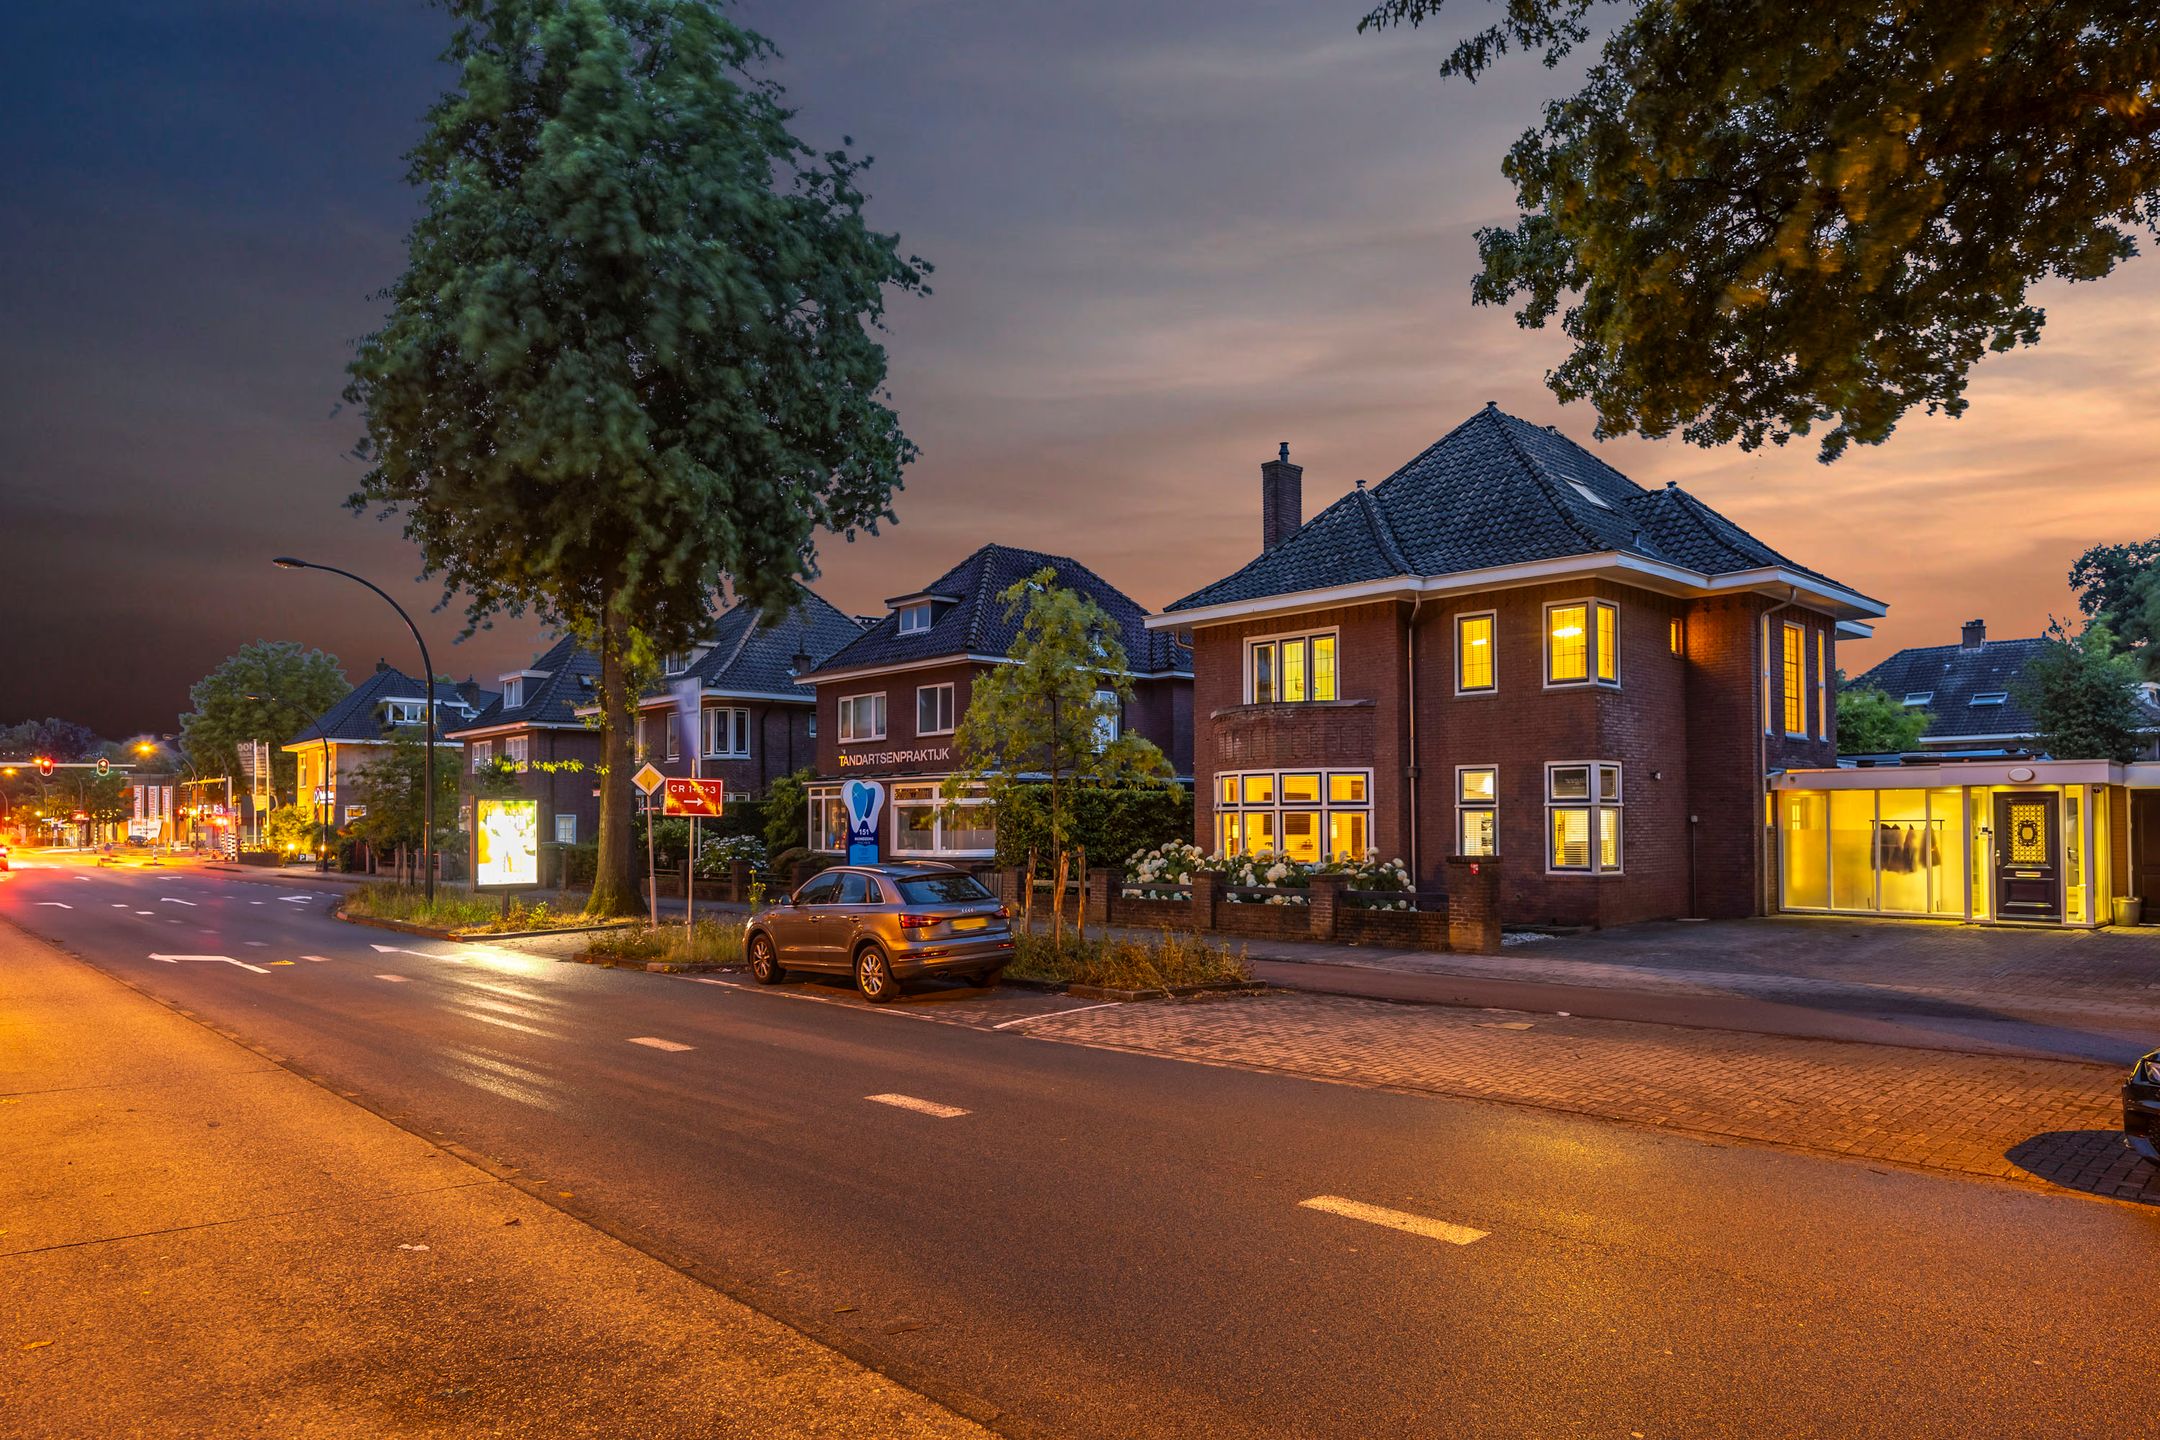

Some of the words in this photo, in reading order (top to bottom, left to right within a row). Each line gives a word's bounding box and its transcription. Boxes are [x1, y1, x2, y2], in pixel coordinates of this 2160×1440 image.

[838, 747, 950, 767] TANDARTSENPRAKTIJK
[670, 784, 685, 793] CR
[859, 828, 870, 836] 151
